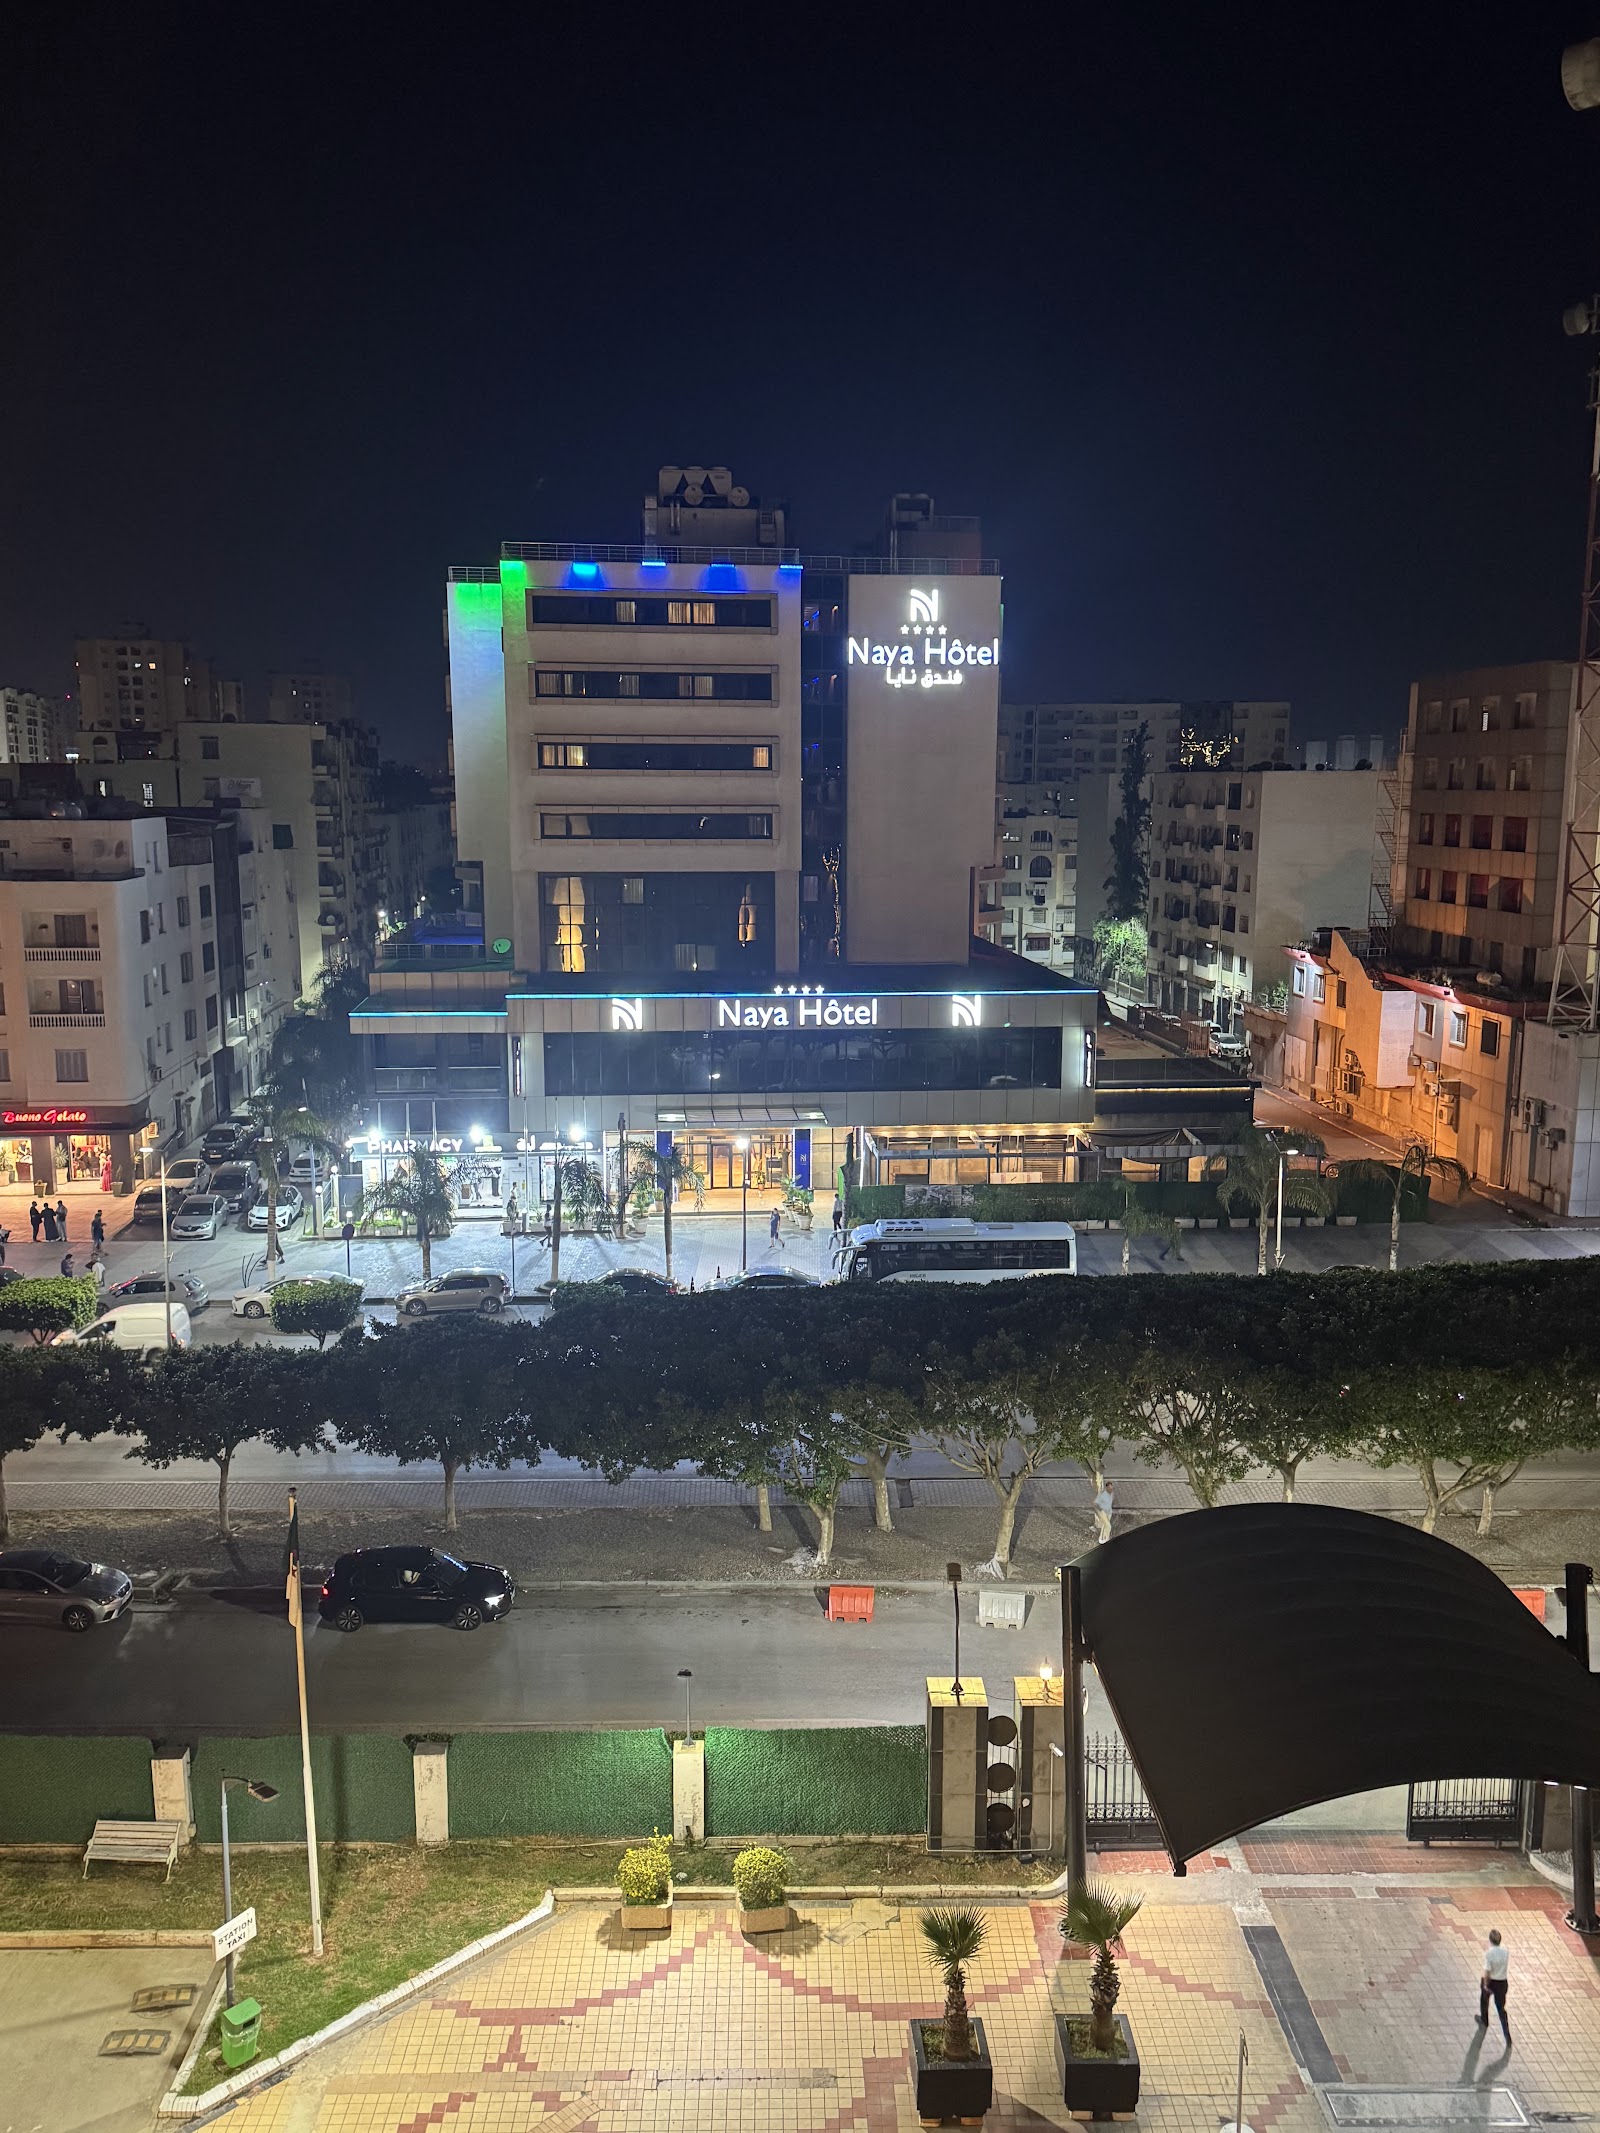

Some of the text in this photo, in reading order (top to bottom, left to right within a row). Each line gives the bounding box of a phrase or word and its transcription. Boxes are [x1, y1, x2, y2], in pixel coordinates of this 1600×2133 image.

[848, 637, 999, 666] Naya Hôtel
[886, 666, 963, 688] فندق نايا
[719, 998, 878, 1028] Naya Hôtel
[1, 1109, 87, 1125] Buono Gelato
[367, 1138, 464, 1153] PHARMACY
[218, 1917, 253, 1945] STATION
[226, 1931, 246, 1949] TAXI
